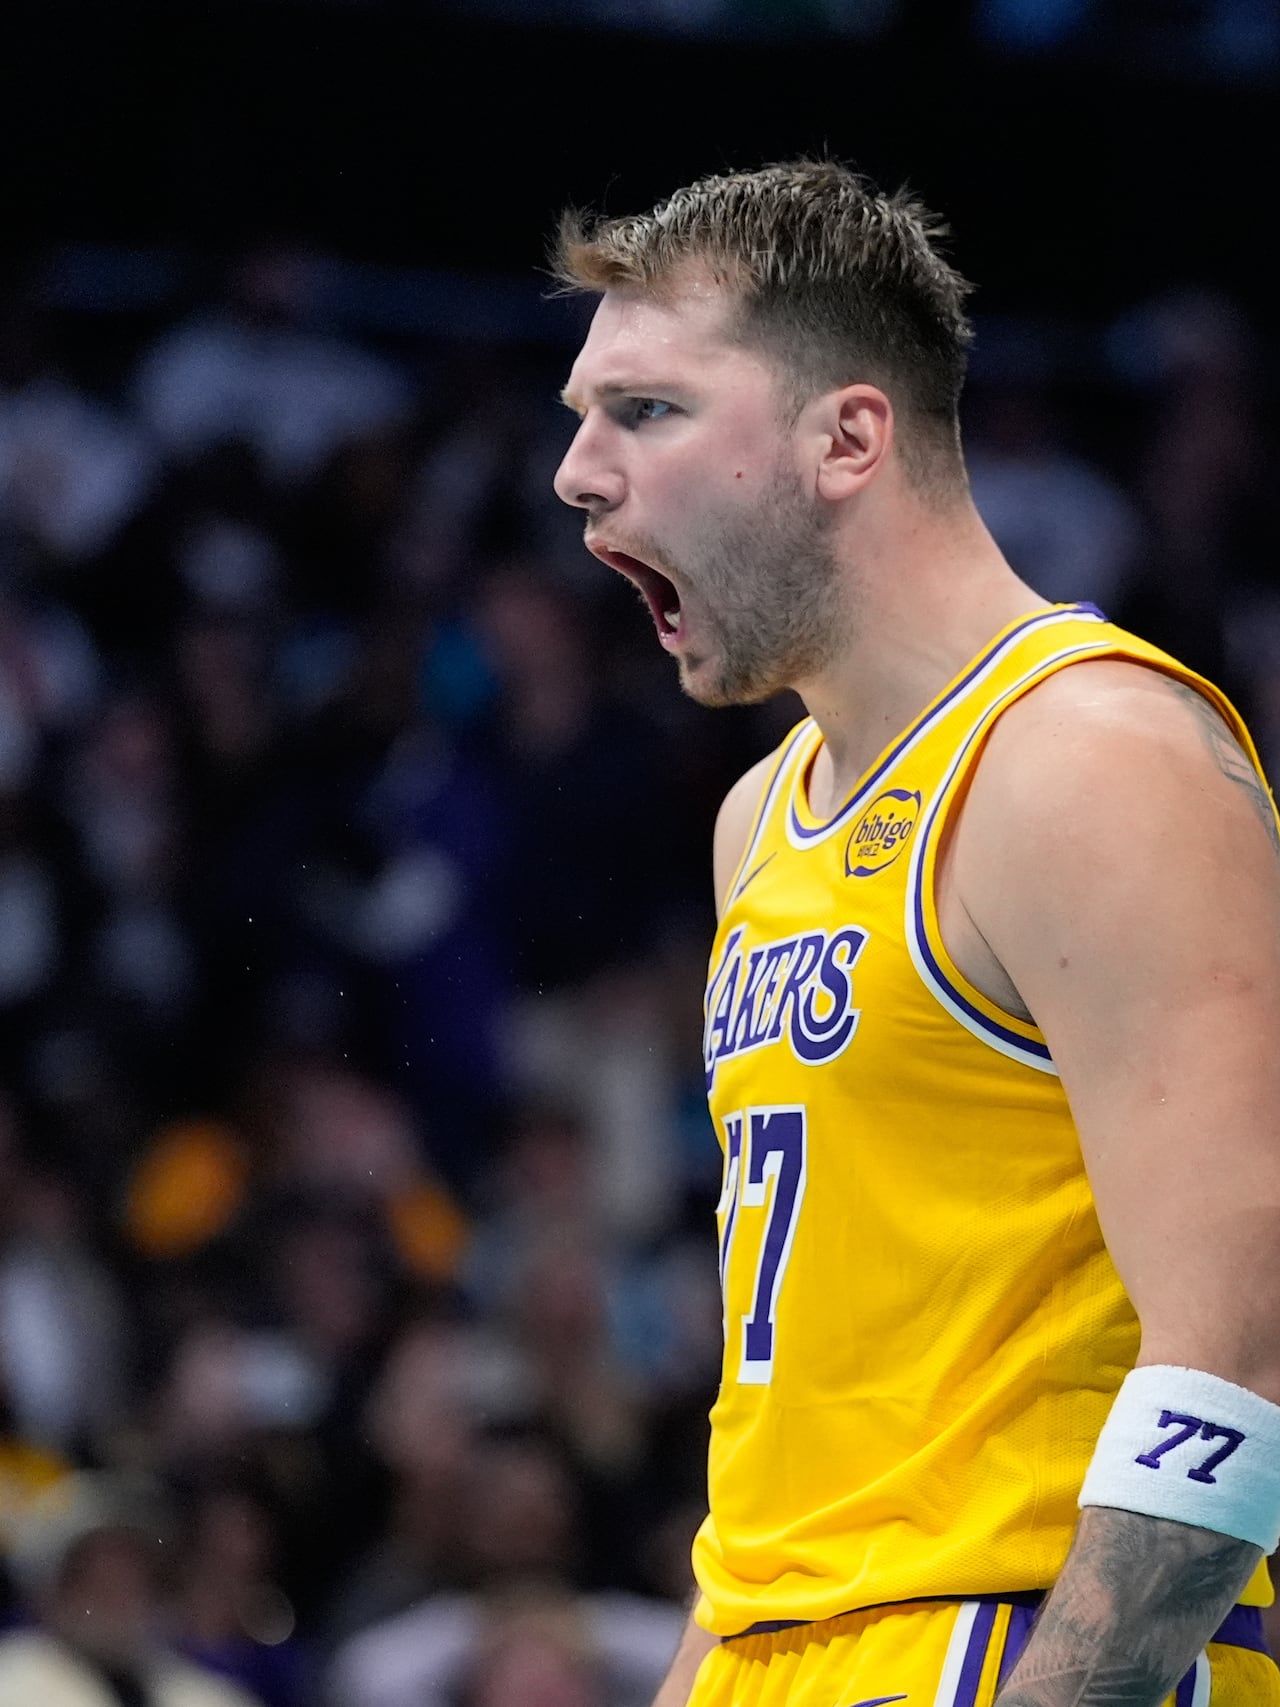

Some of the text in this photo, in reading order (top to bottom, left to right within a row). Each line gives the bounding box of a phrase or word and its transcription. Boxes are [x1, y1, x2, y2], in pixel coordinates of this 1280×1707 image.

[855, 813, 913, 849] bibigo
[716, 1104, 807, 1384] 77
[1135, 1410, 1246, 1484] 77
